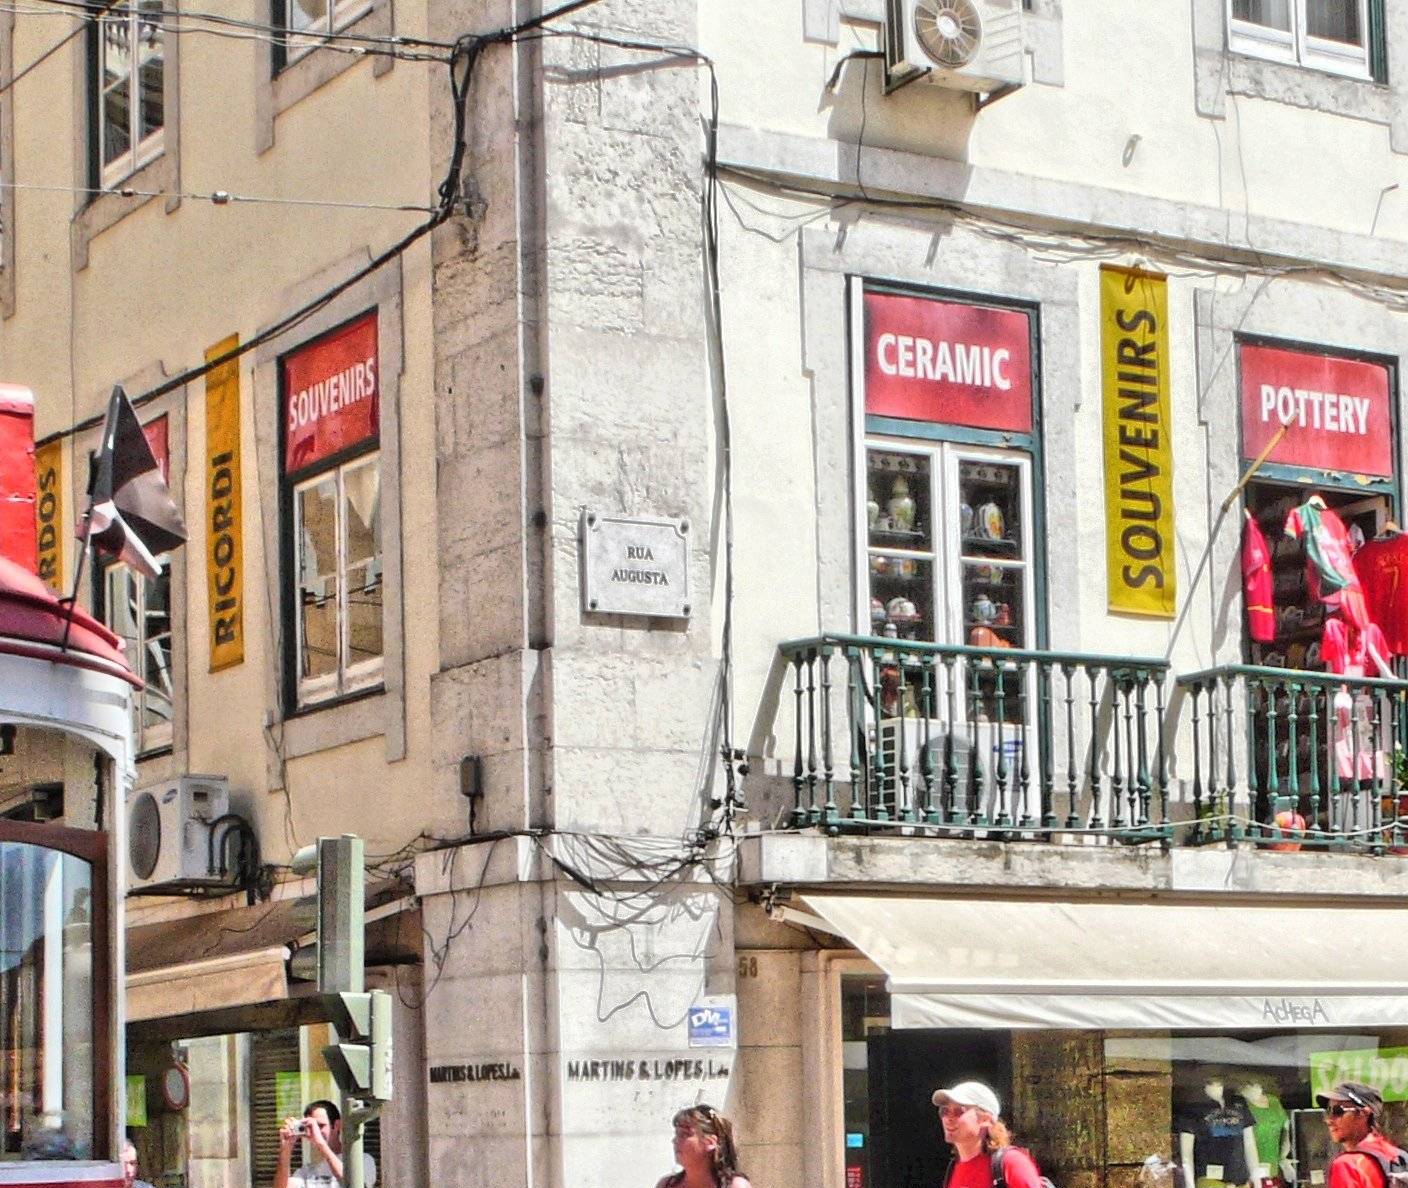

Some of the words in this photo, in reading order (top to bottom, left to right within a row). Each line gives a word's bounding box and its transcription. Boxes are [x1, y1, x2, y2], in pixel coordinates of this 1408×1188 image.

[876, 331, 1012, 391] CERAMIC
[287, 354, 377, 431] SOUVENIRS
[1260, 383, 1371, 435] POTTERY
[1115, 308, 1164, 590] SOUVENIRS
[38, 466, 57, 581] RDOS
[211, 451, 237, 648] RICORDI
[611, 568, 670, 587] AUGUSTA
[626, 545, 655, 561] RUA
[1262, 997, 1330, 1025] ACHEGA
[567, 1060, 635, 1082] MARTINS
[638, 1060, 650, 1081] &
